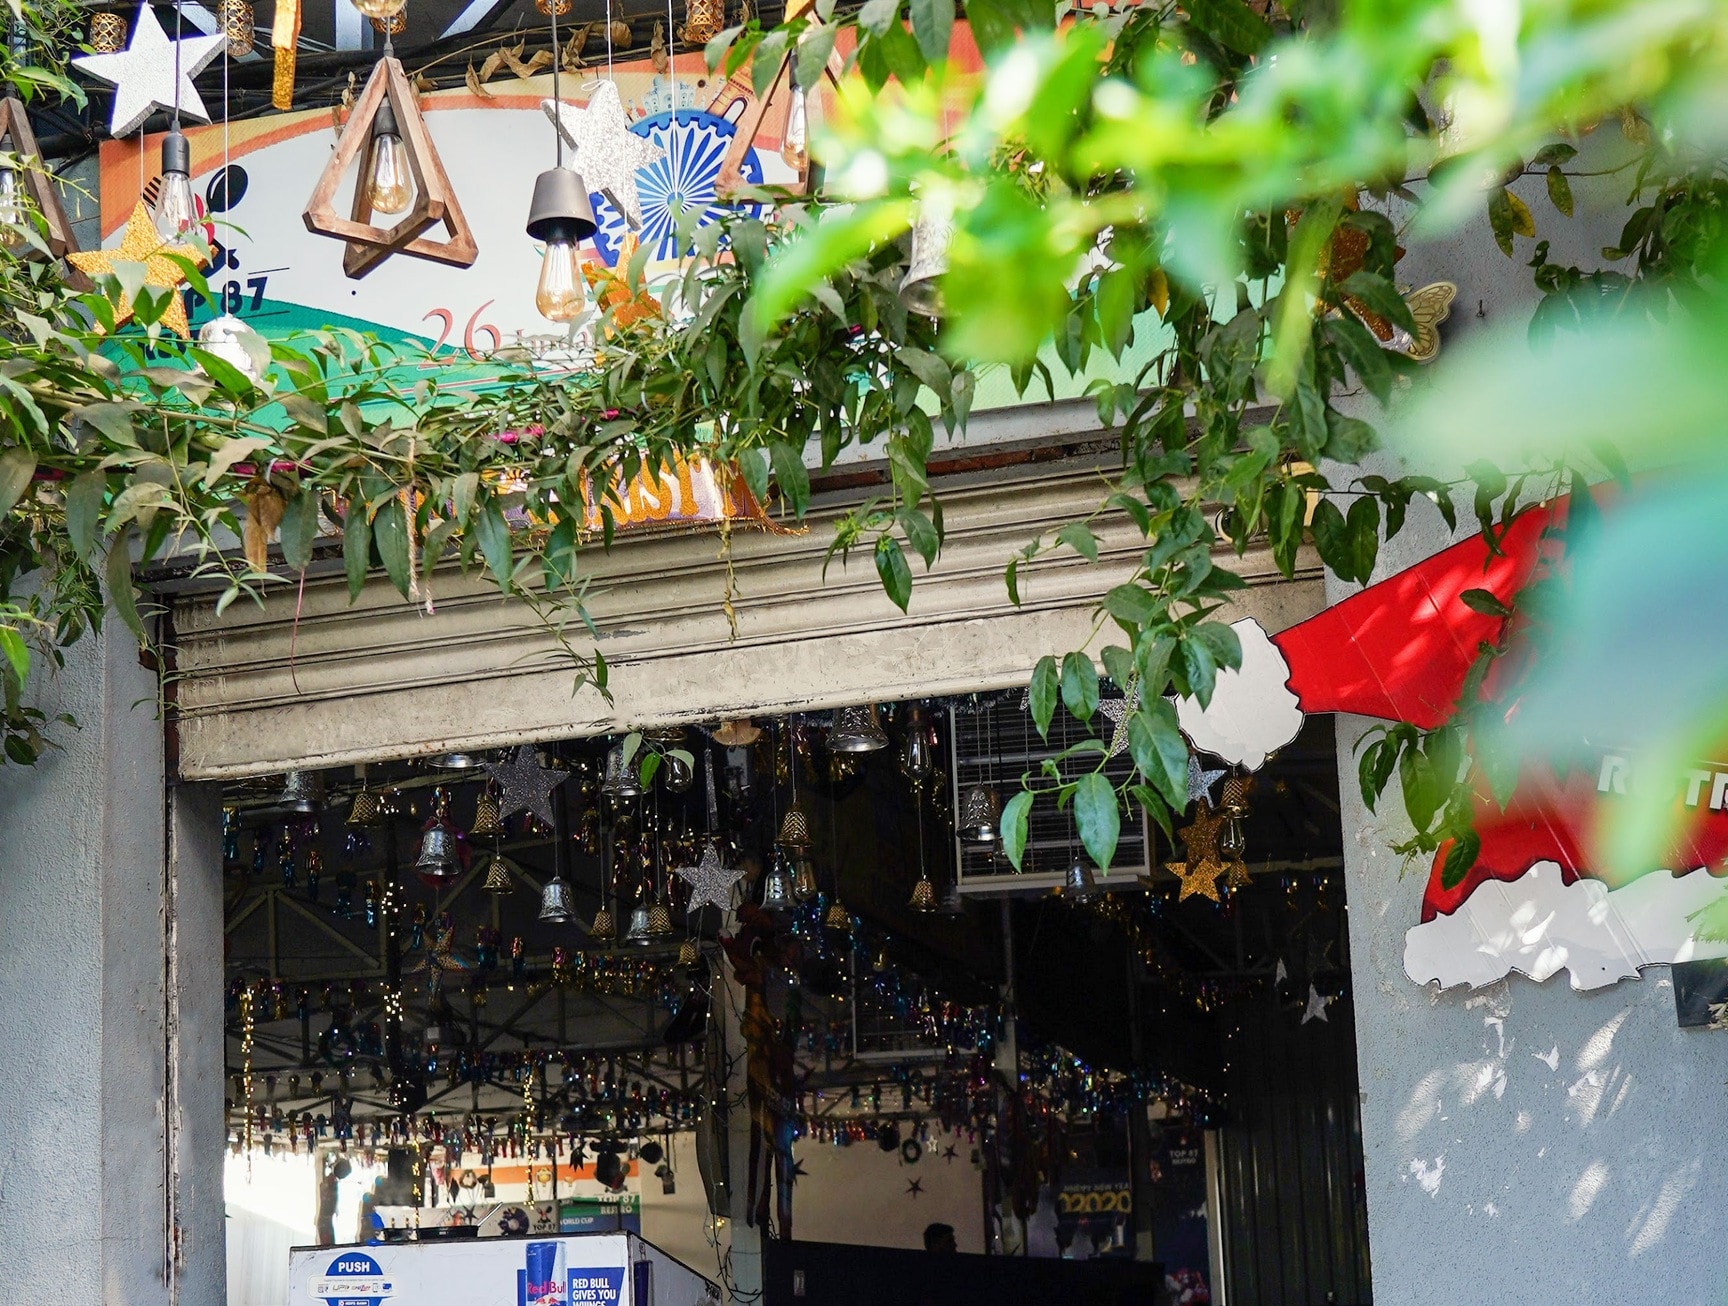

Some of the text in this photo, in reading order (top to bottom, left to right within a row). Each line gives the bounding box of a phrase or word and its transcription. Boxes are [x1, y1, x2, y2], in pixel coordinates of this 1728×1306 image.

[220, 276, 268, 314] 87
[417, 298, 502, 372] 26
[560, 1217, 580, 1225] ORLD
[338, 1261, 370, 1273] PUSH
[528, 1280, 547, 1294] Red
[572, 1278, 609, 1289] RED BULL
[572, 1289, 617, 1300] GIVES YOU
